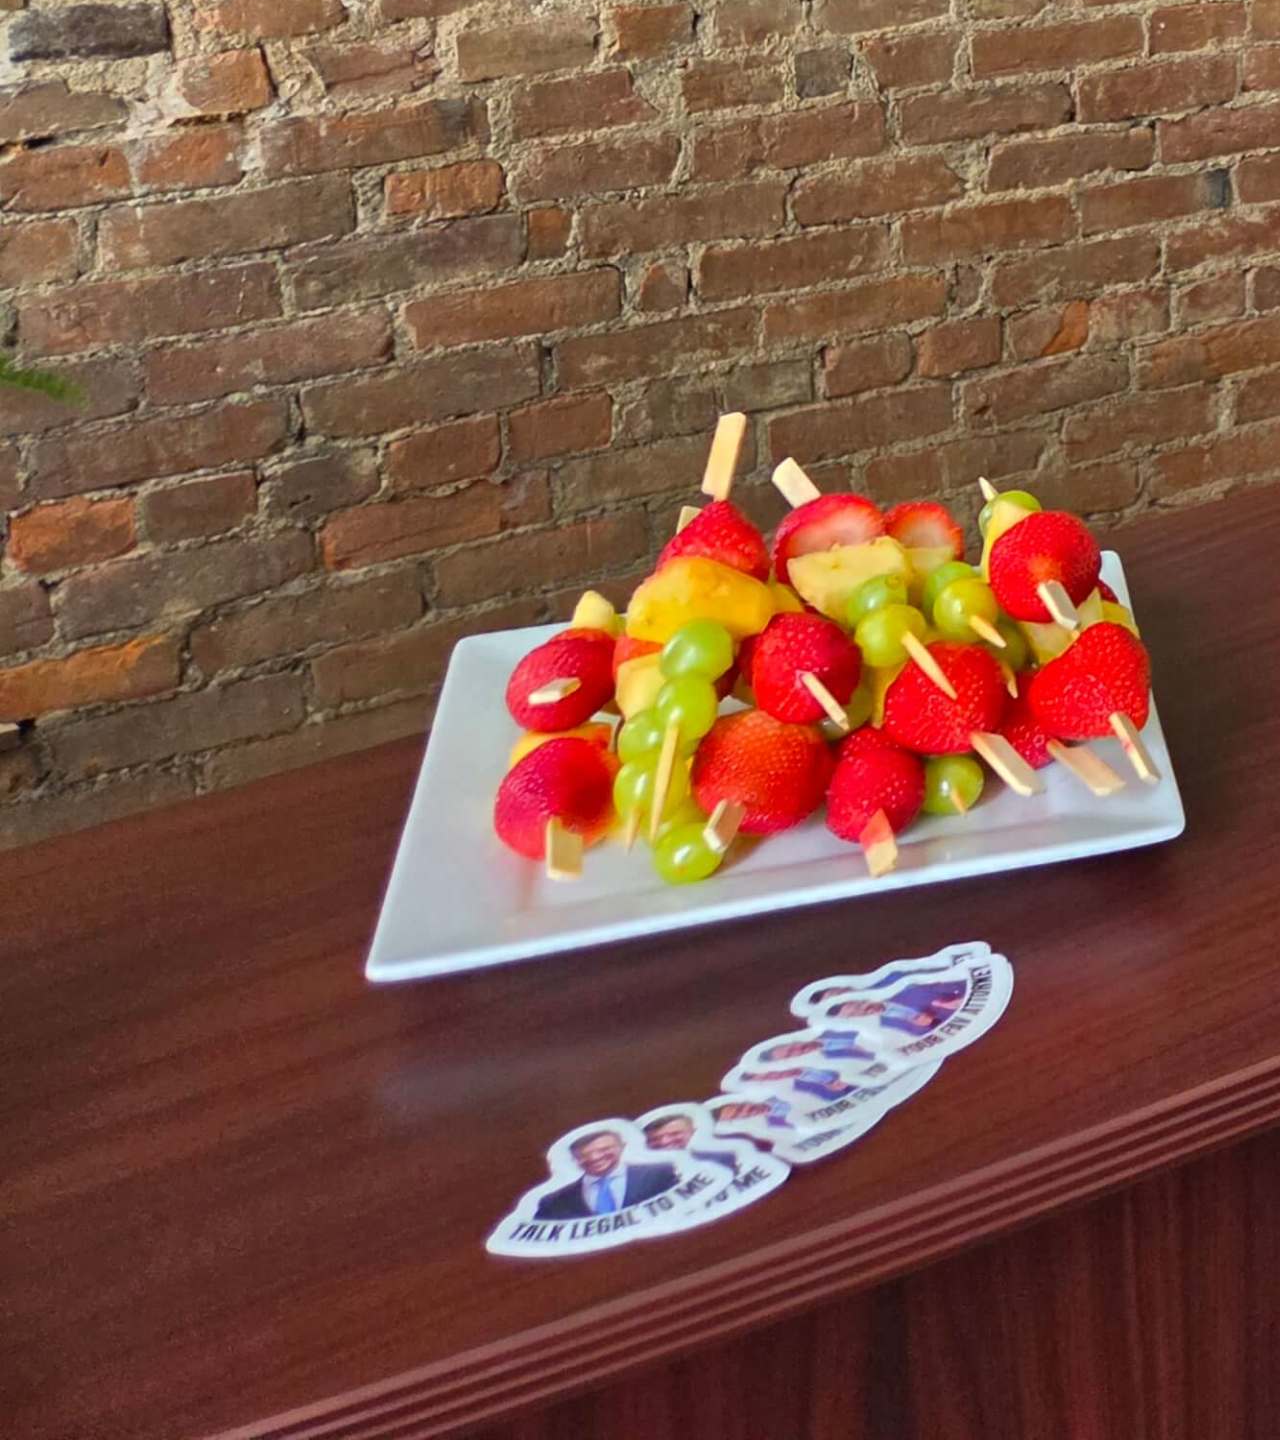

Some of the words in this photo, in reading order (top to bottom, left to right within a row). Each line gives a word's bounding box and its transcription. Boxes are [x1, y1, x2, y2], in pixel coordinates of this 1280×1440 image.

[508, 1223, 565, 1241] TALK
[568, 1208, 640, 1240] LEGAL
[636, 1196, 674, 1217] TO
[674, 1172, 715, 1200] ME
